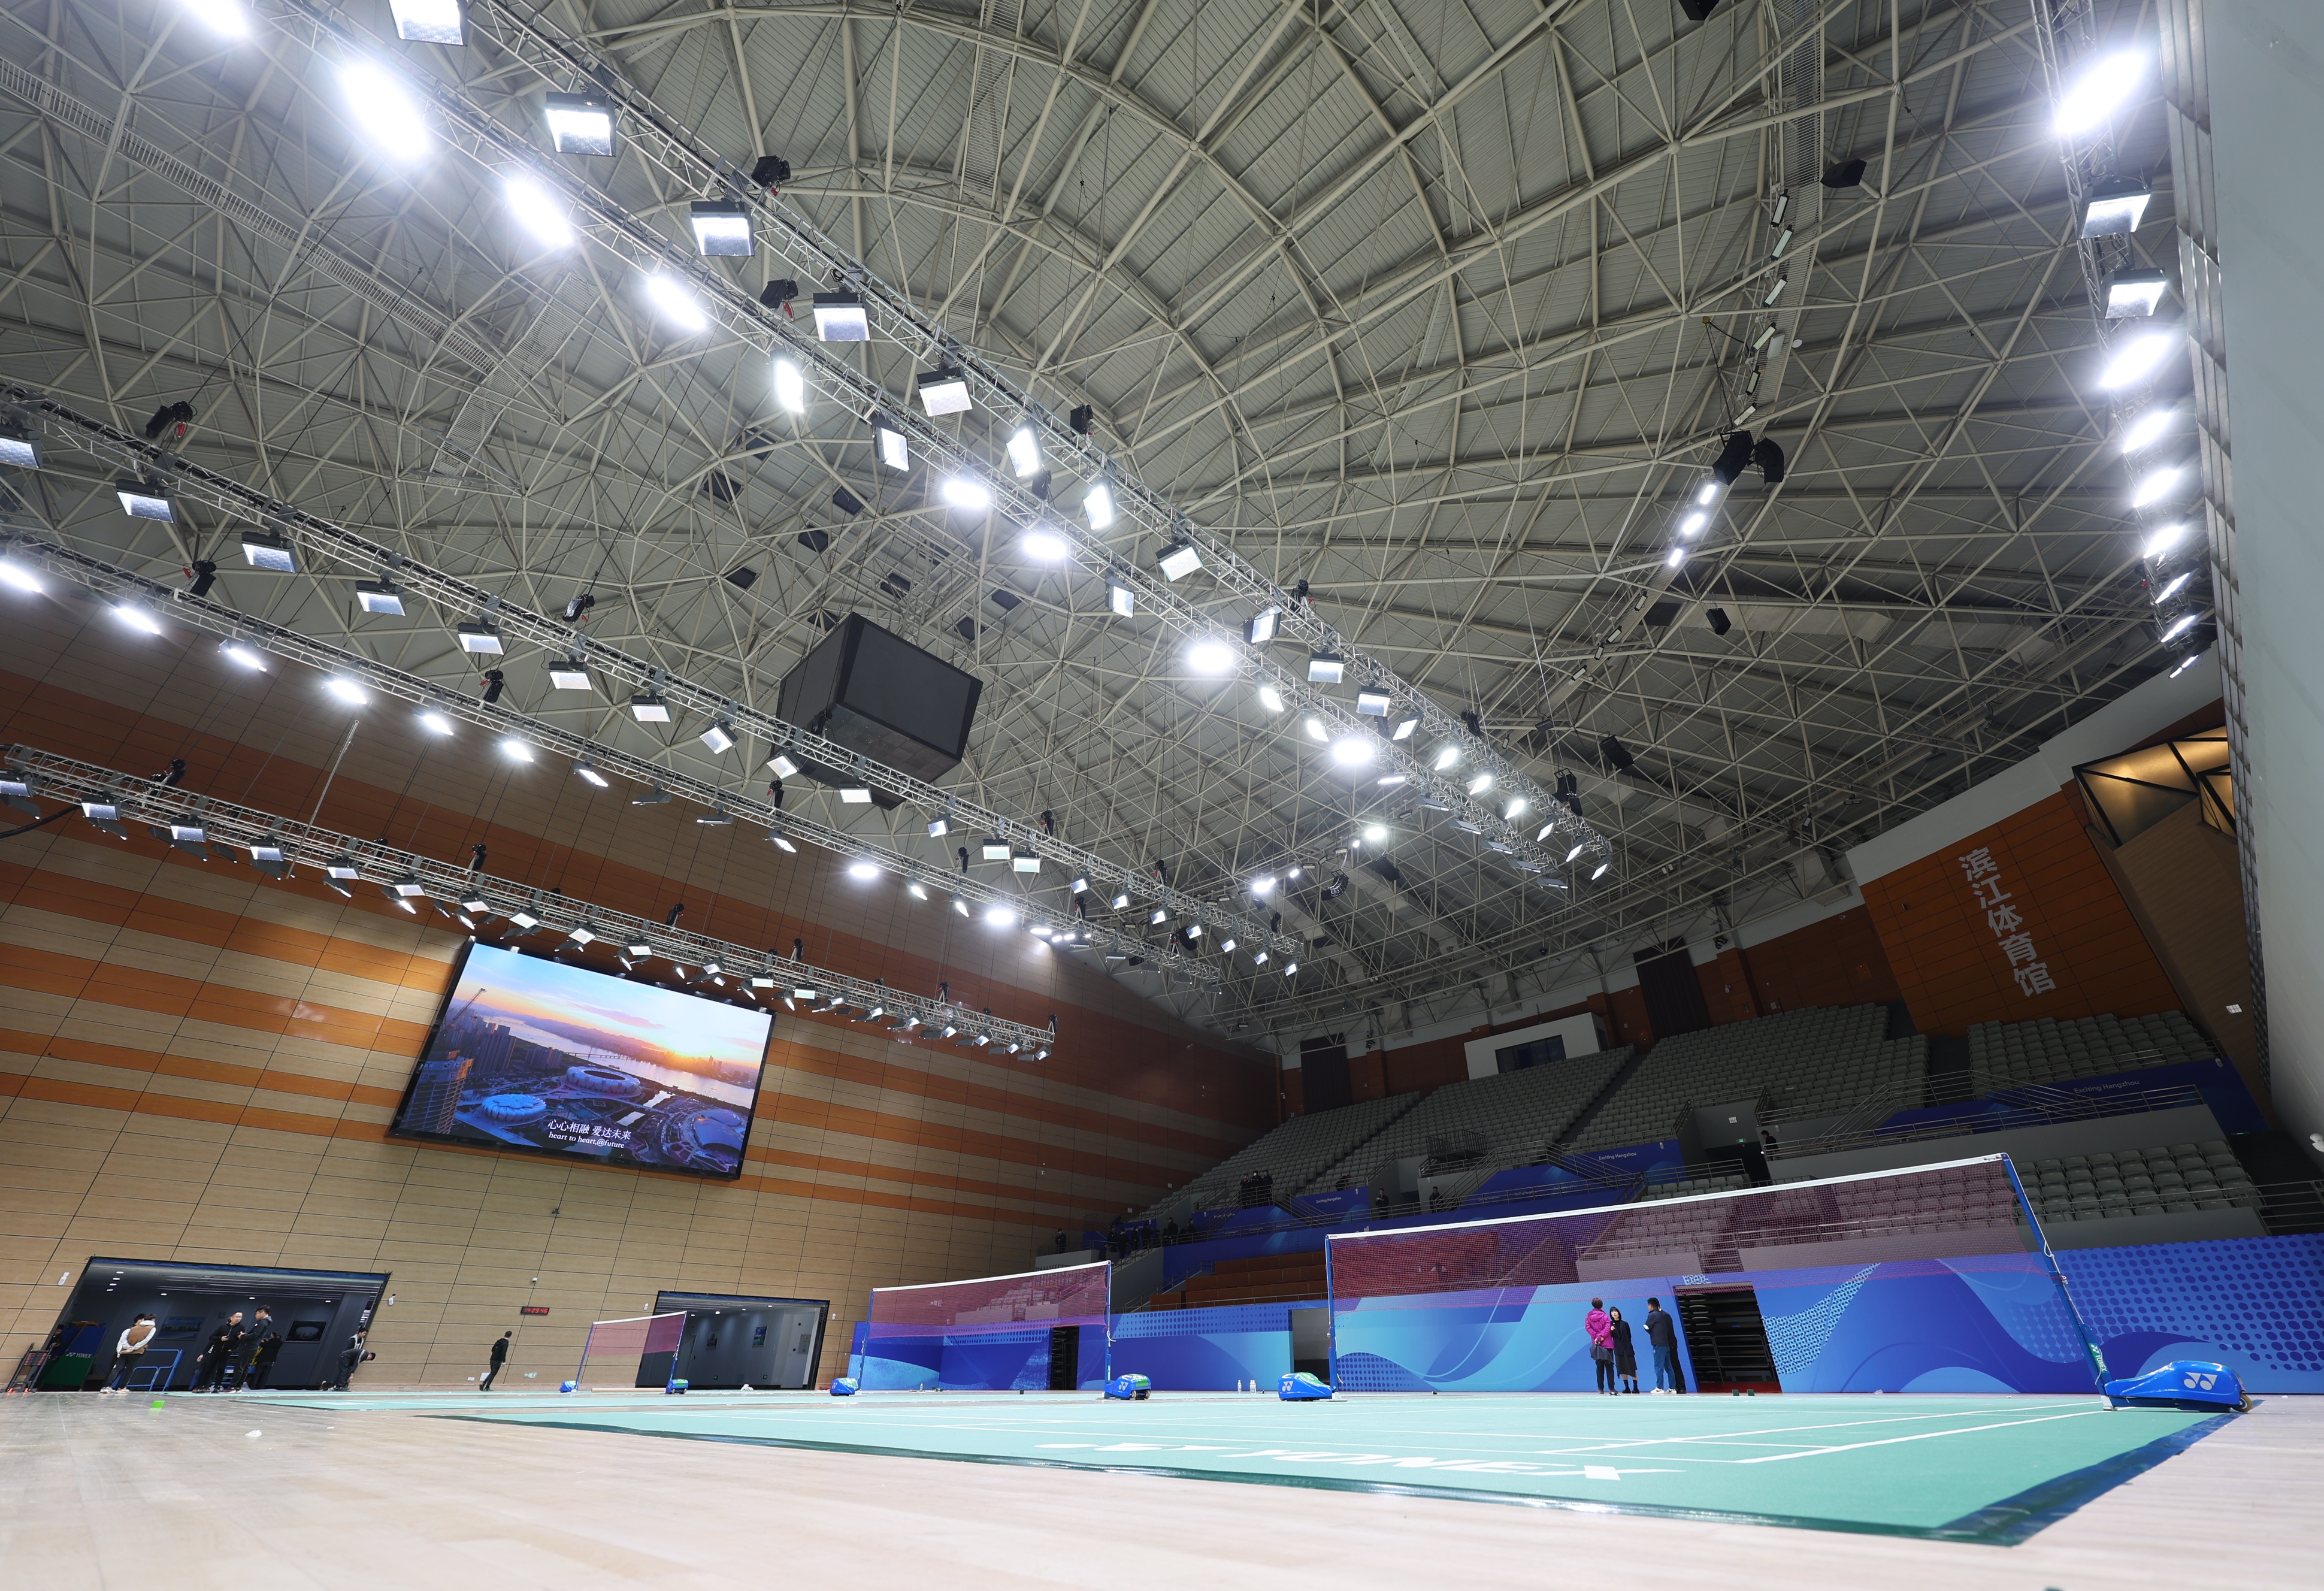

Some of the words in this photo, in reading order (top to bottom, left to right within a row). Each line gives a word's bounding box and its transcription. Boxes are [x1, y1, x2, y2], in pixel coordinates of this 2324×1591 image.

[1958, 846, 2056, 997] 滨江体育馆
[2102, 1080, 2140, 1090] Hangzhou
[547, 1119, 591, 1135] 心心相融
[591, 1126, 631, 1141] 爱达未来
[549, 1132, 568, 1141] heart
[2095, 1354, 2108, 1372] YONEX
[1216, 1449, 1687, 1481] YONEX
